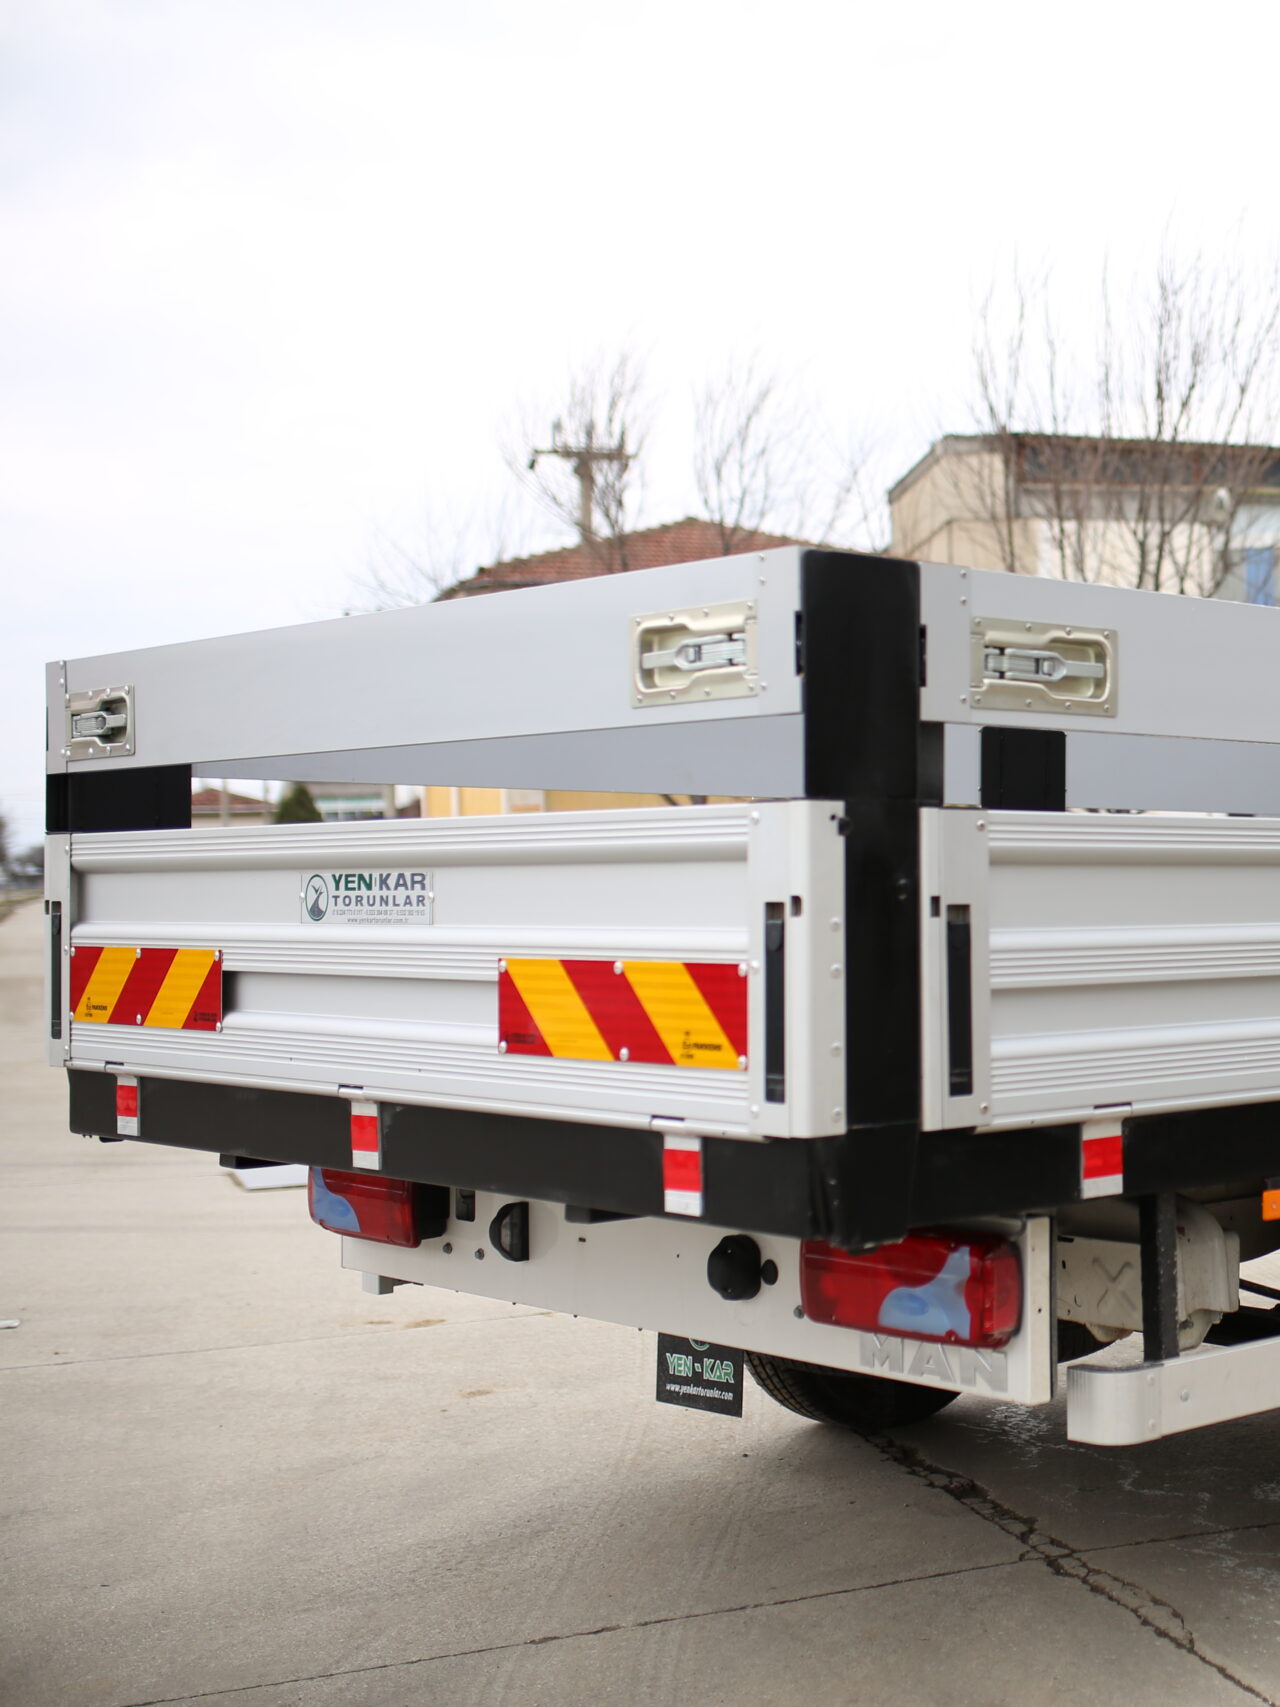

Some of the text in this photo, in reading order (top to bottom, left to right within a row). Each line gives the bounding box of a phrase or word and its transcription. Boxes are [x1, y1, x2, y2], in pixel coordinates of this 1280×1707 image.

[332, 873, 426, 891] YEN KAR
[332, 895, 426, 907] TORUNLAR
[665, 1353, 692, 1377] YEN
[703, 1358, 735, 1383] KAR
[860, 1332, 1008, 1393] MAN
